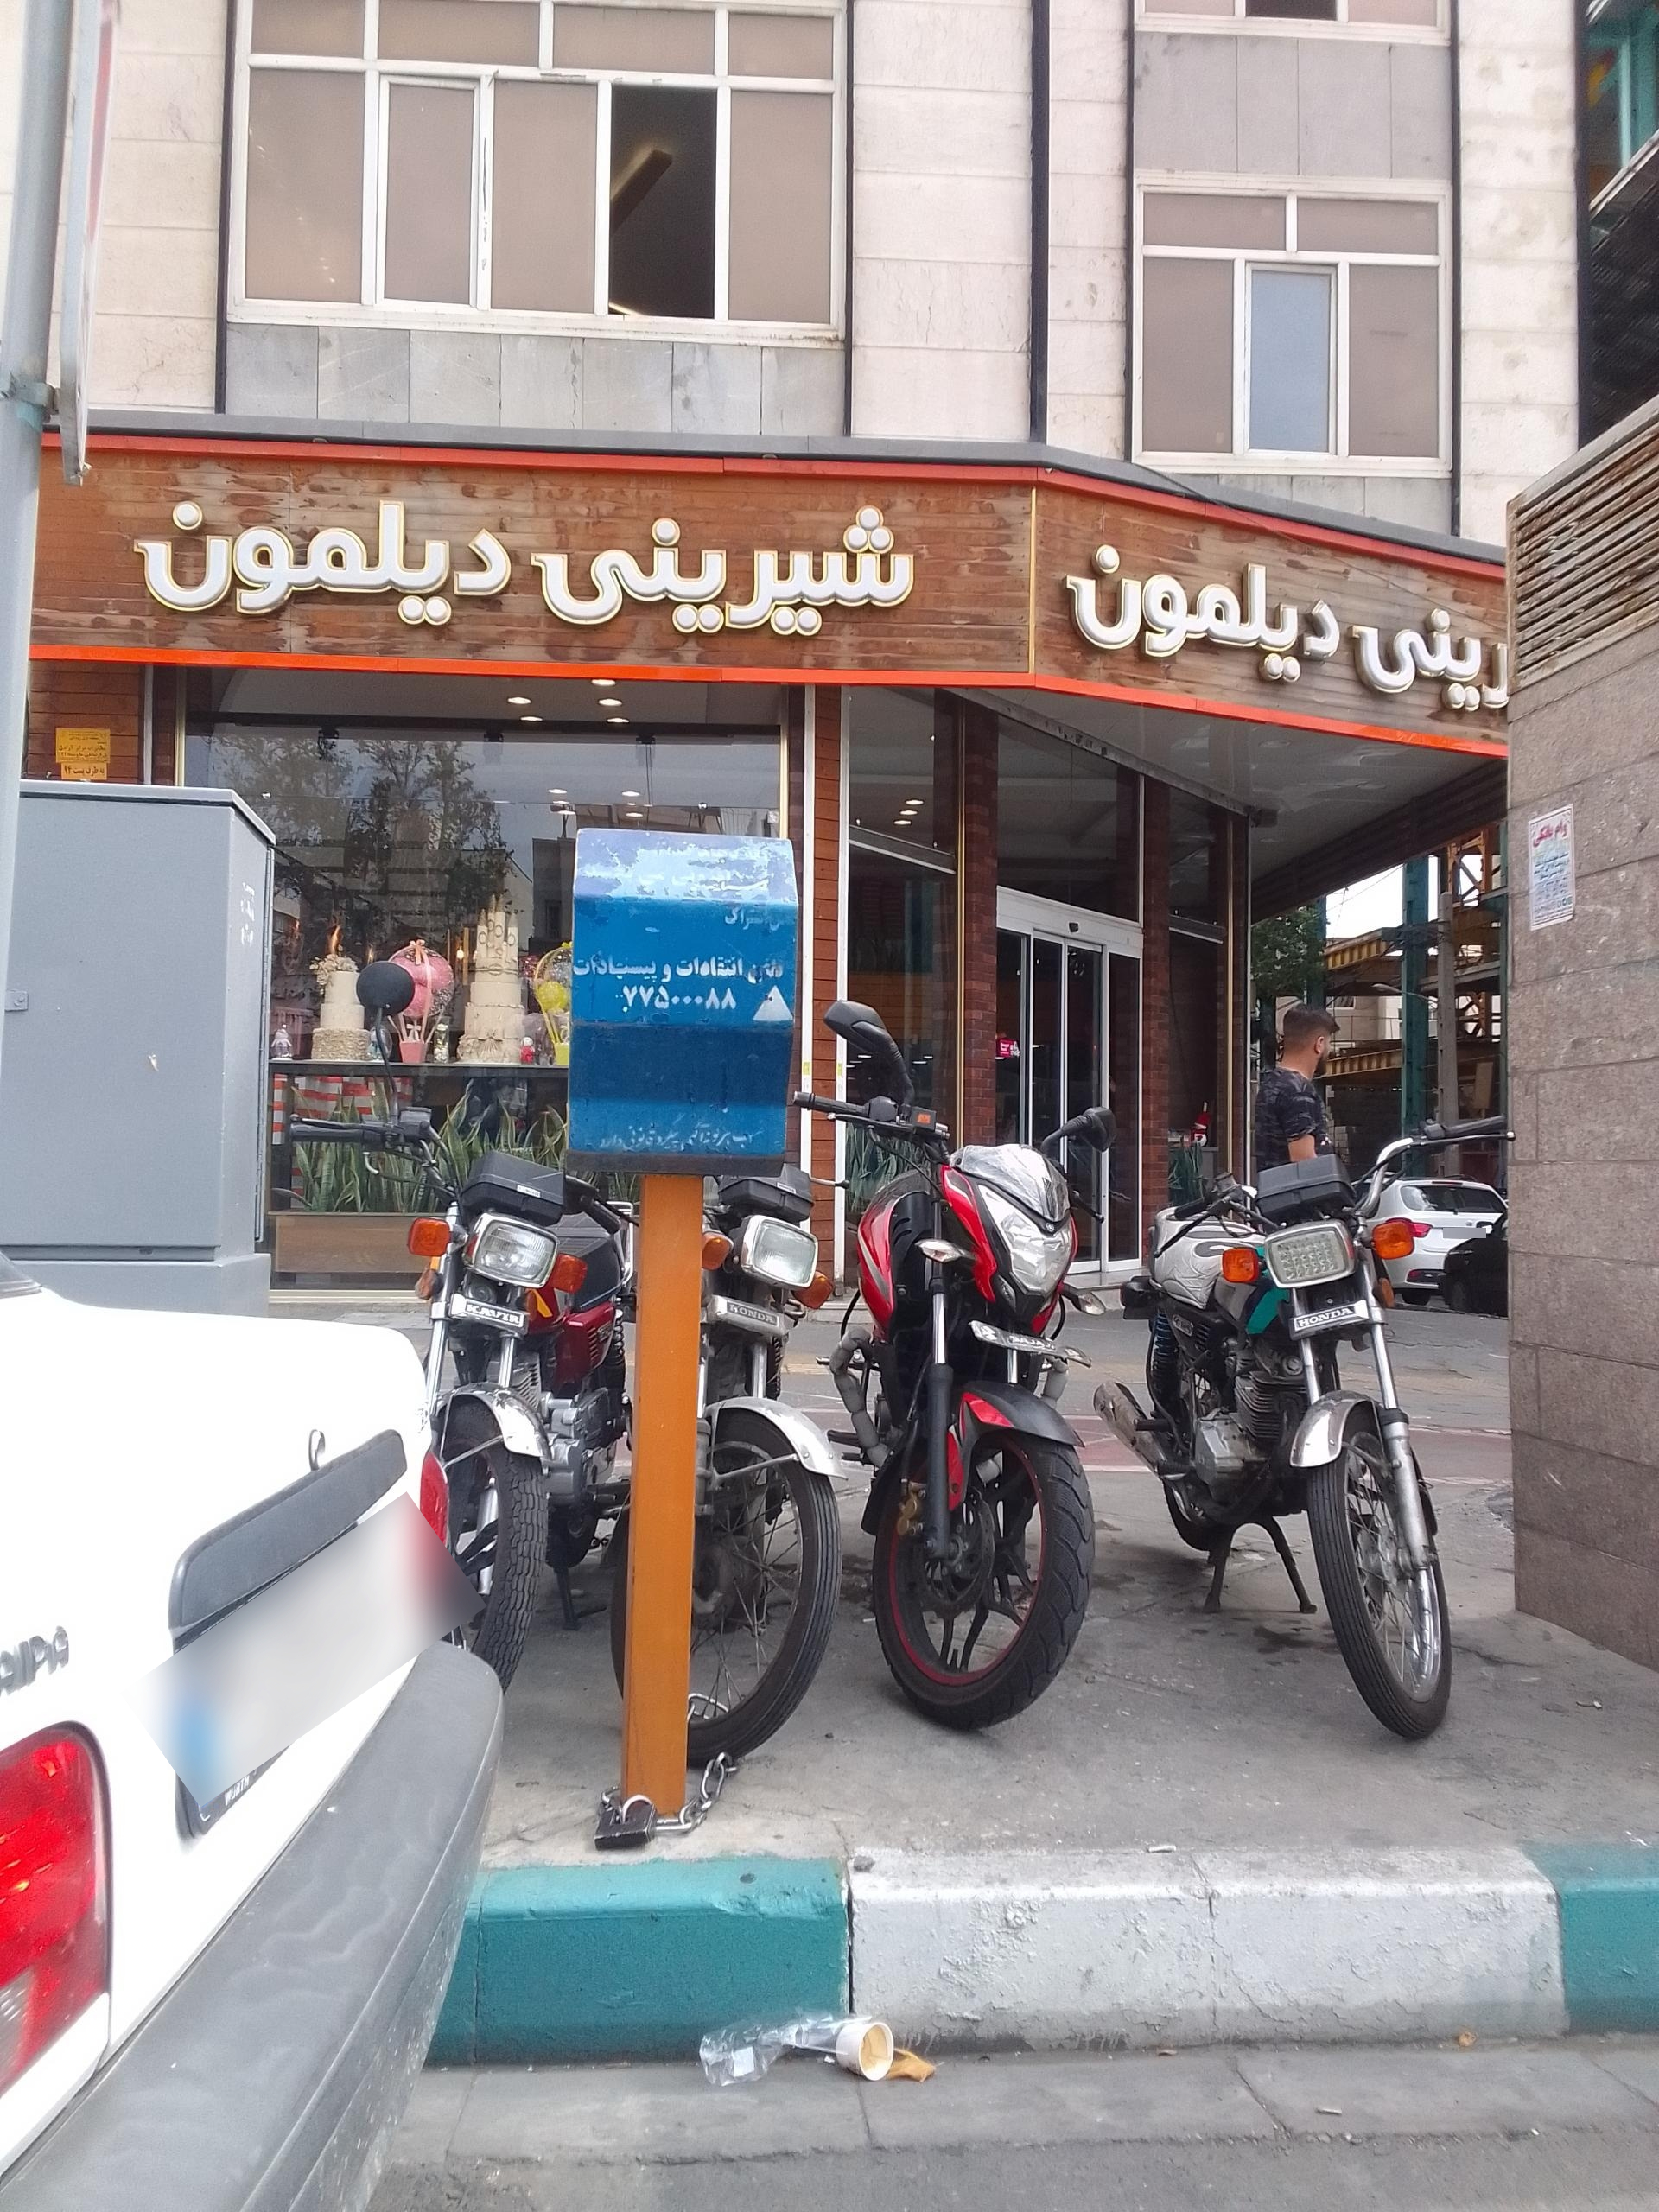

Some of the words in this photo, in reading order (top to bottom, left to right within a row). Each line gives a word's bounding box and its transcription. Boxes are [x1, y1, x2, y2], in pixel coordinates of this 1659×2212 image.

[133, 499, 512, 626] دیلمون
[531, 505, 915, 636] شیرینی
[1064, 544, 1340, 683] دیلمون
[1349, 607, 1509, 712] رینی
[467, 1303, 520, 1324] KAVIR
[729, 1303, 777, 1323] HONDA
[1298, 1307, 1354, 1327] HONDA
